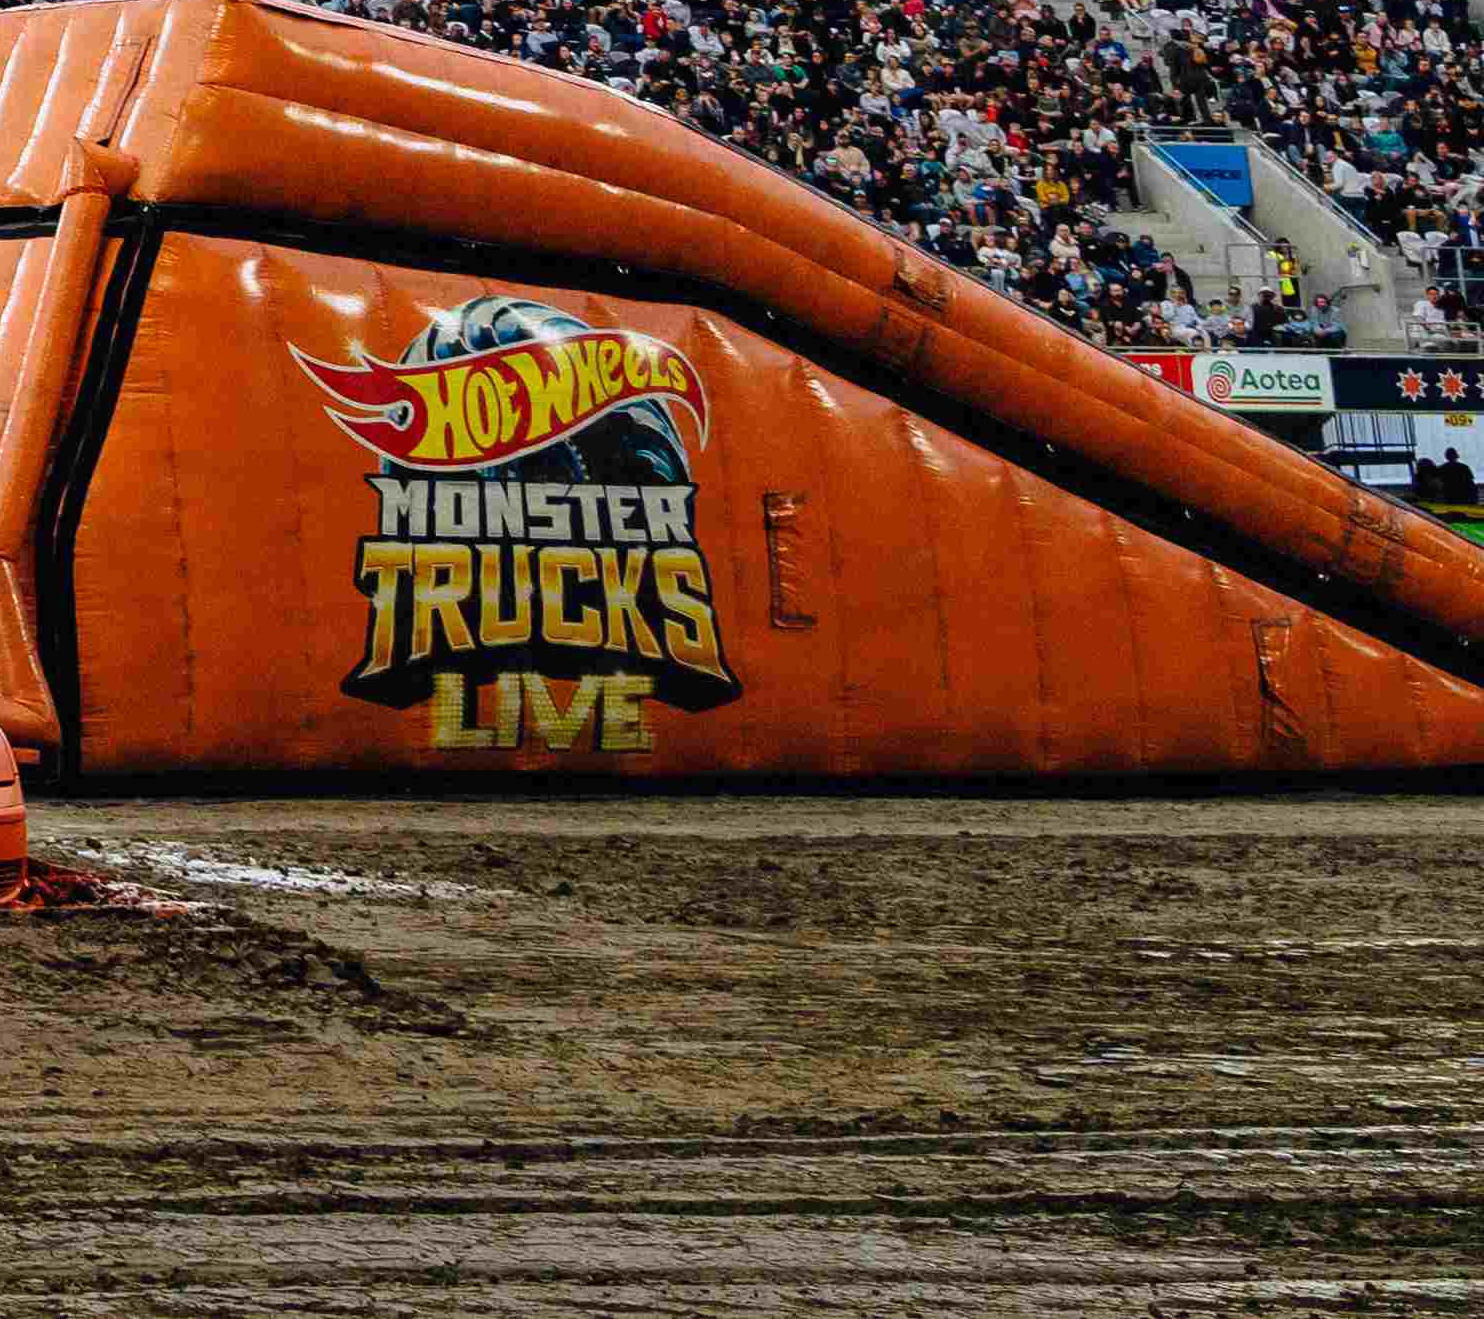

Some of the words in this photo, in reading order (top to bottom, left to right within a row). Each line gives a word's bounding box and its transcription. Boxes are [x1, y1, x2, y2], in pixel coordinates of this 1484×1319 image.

[1241, 368, 1321, 392] Aotea
[366, 477, 698, 544] MONSTER
[358, 543, 734, 685] TRUCKS
[431, 670, 657, 752] LIVE
